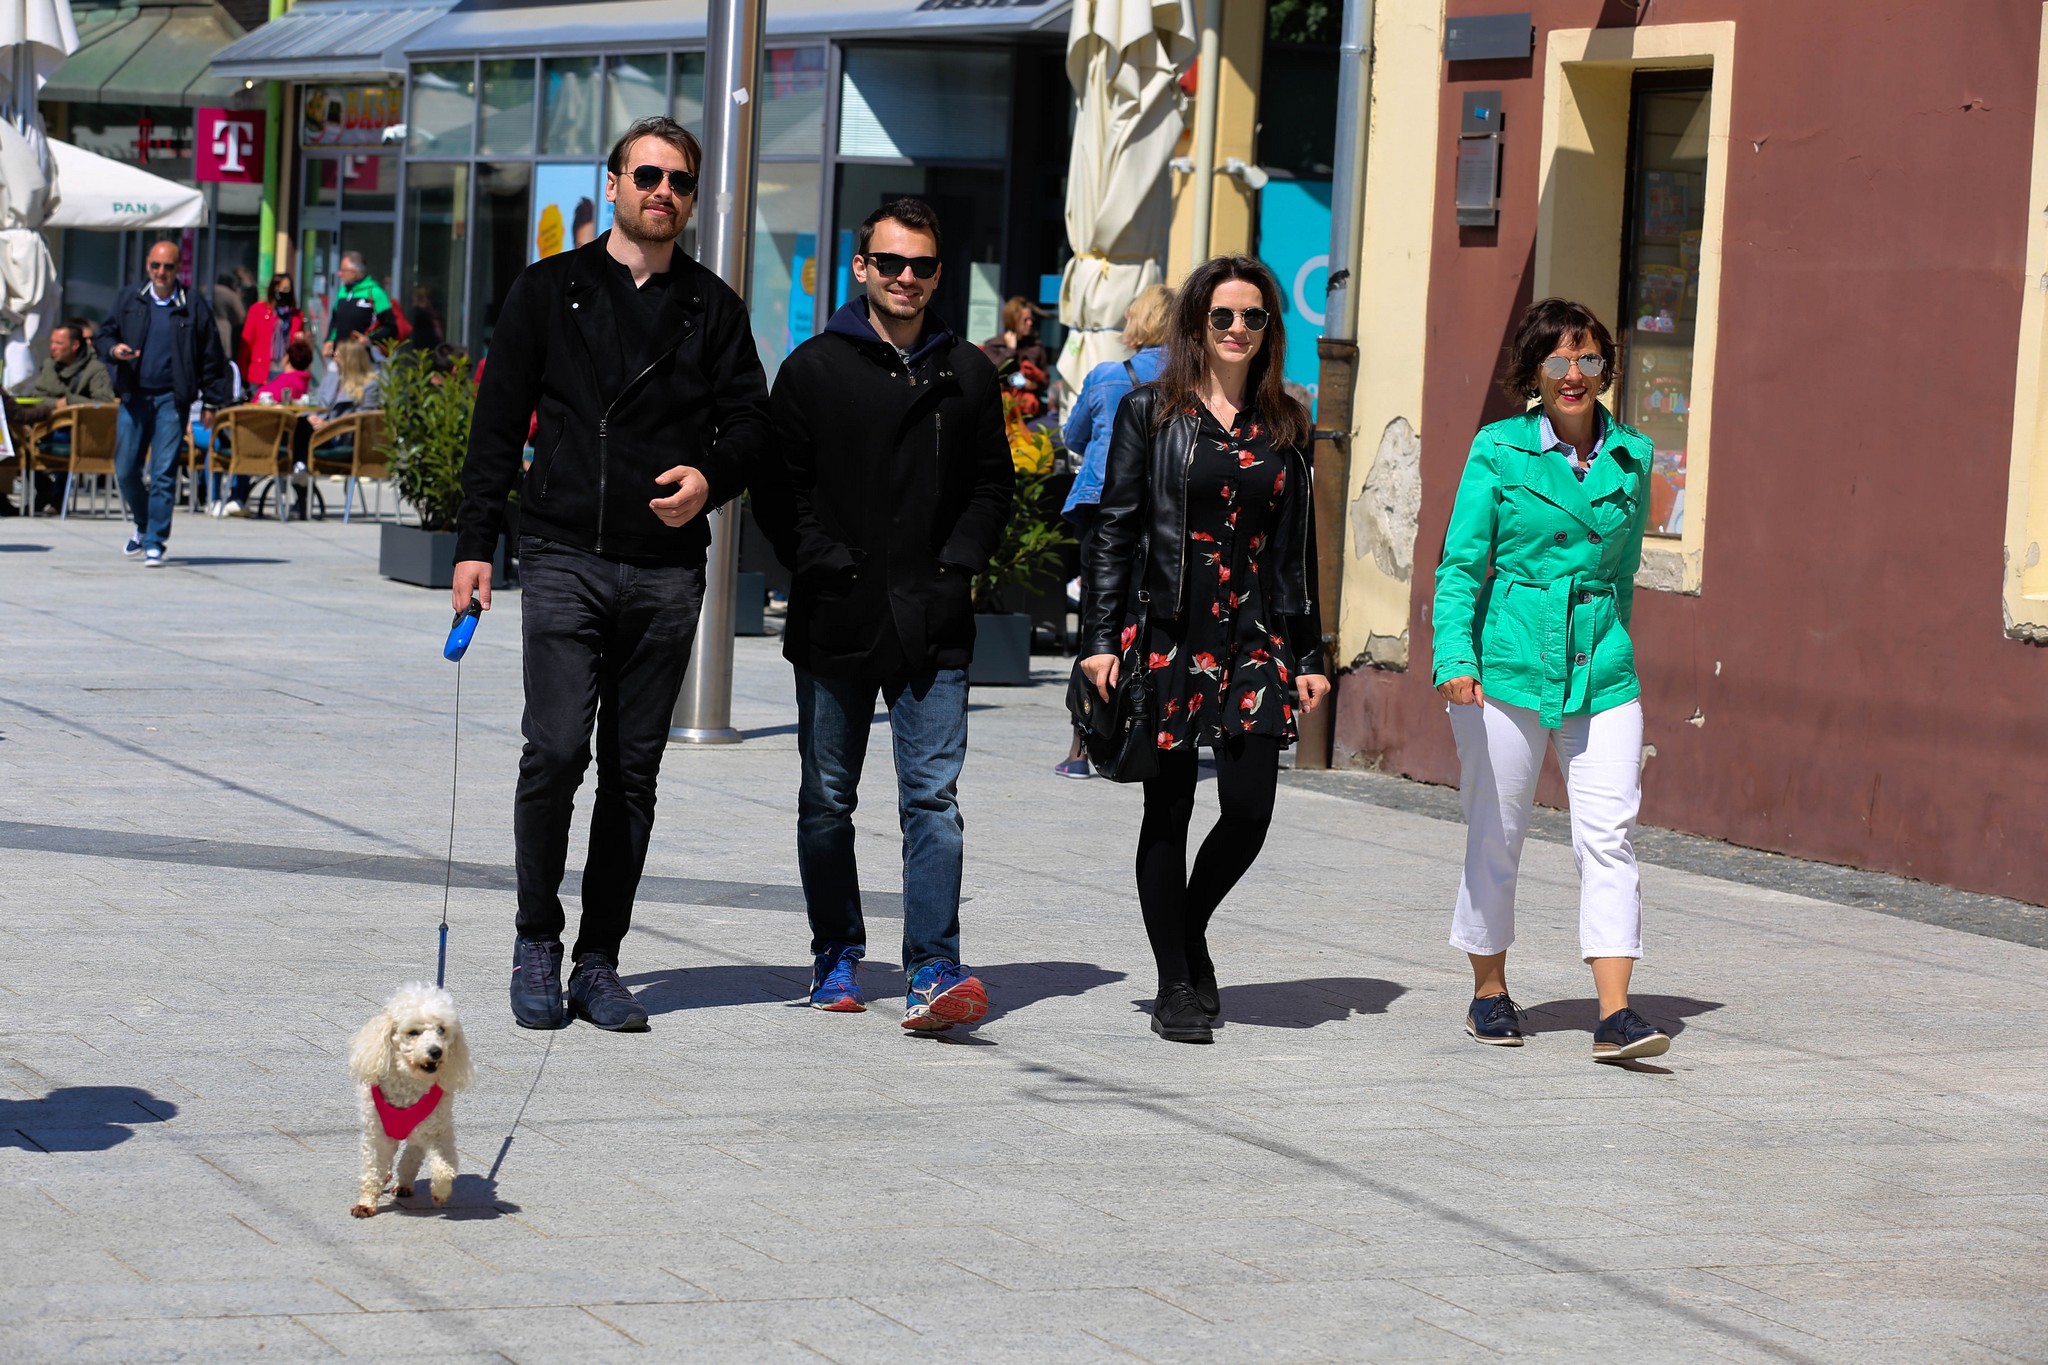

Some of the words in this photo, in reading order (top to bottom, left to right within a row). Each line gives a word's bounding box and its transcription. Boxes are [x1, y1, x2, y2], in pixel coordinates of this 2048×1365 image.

[346, 88, 401, 129] BASH
[212, 120, 253, 172] T
[113, 202, 147, 214] PAN
